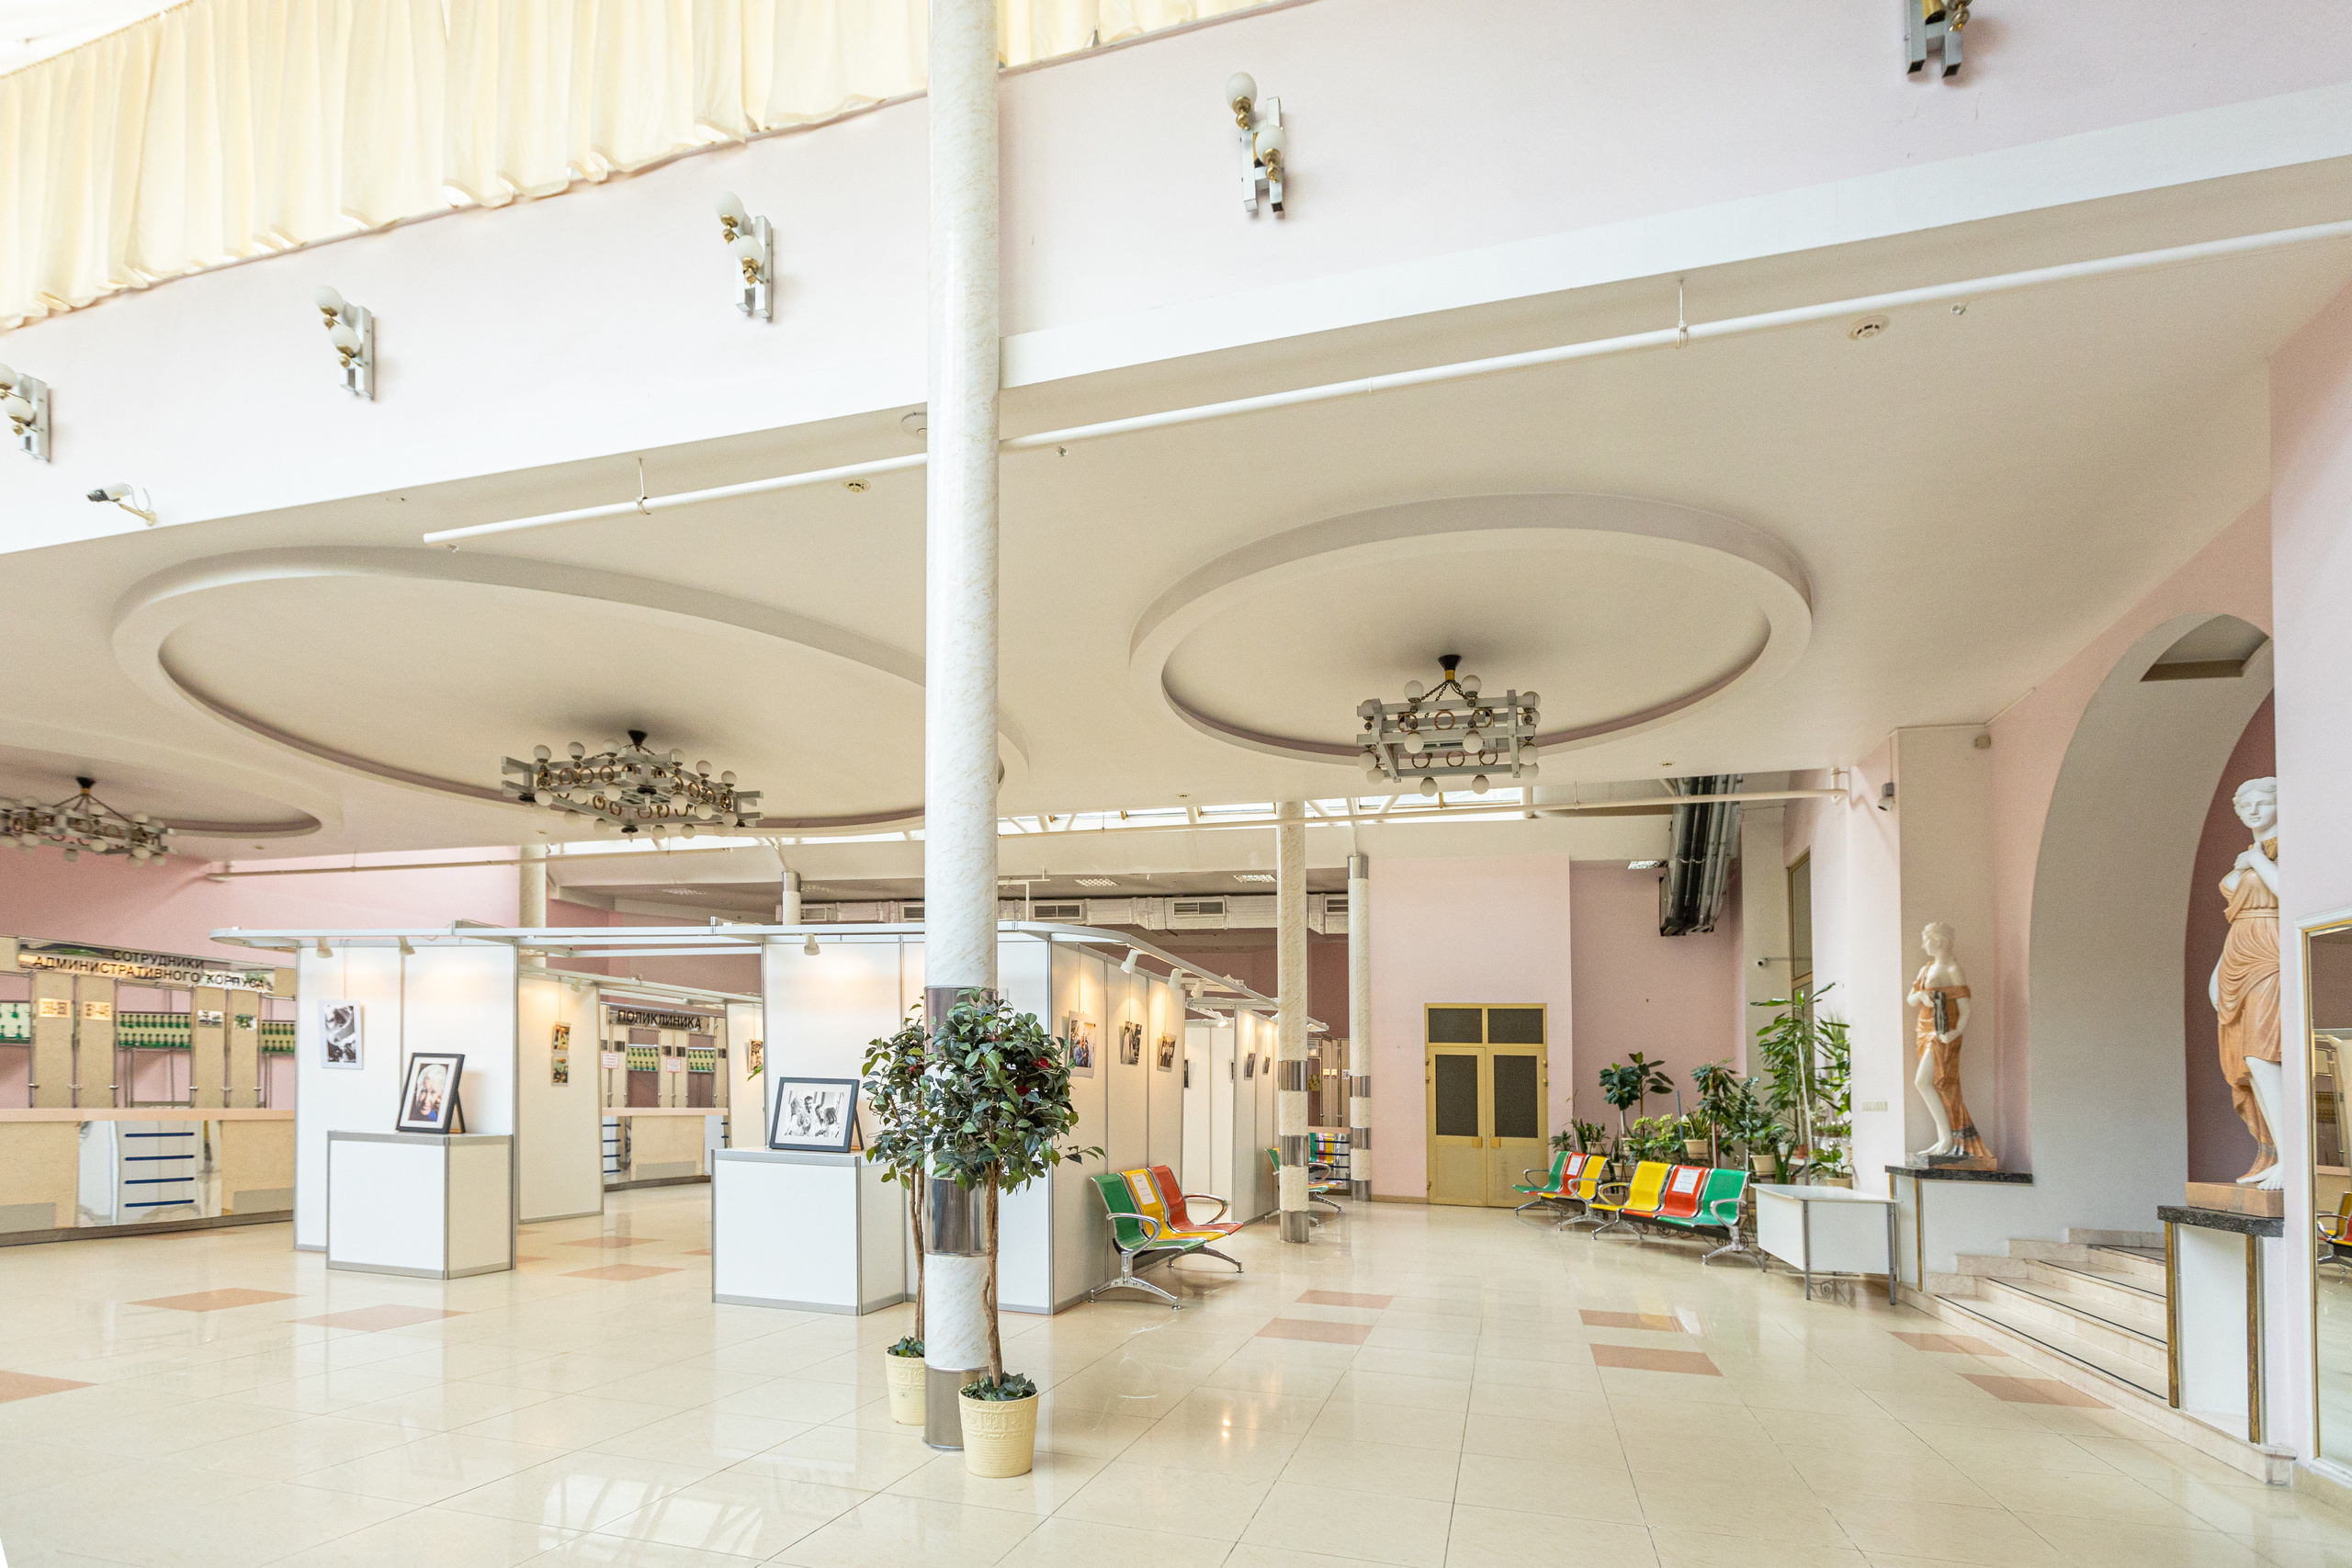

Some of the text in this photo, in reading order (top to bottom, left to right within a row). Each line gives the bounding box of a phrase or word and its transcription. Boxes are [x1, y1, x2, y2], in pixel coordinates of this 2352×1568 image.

[111, 950, 204, 969] СОТРУДНИКИ
[33, 956, 264, 989] АДМИНИСТРАТИВНОГО КОРПУСА
[617, 1010, 702, 1030] ПОЛИКЛИНИКА
